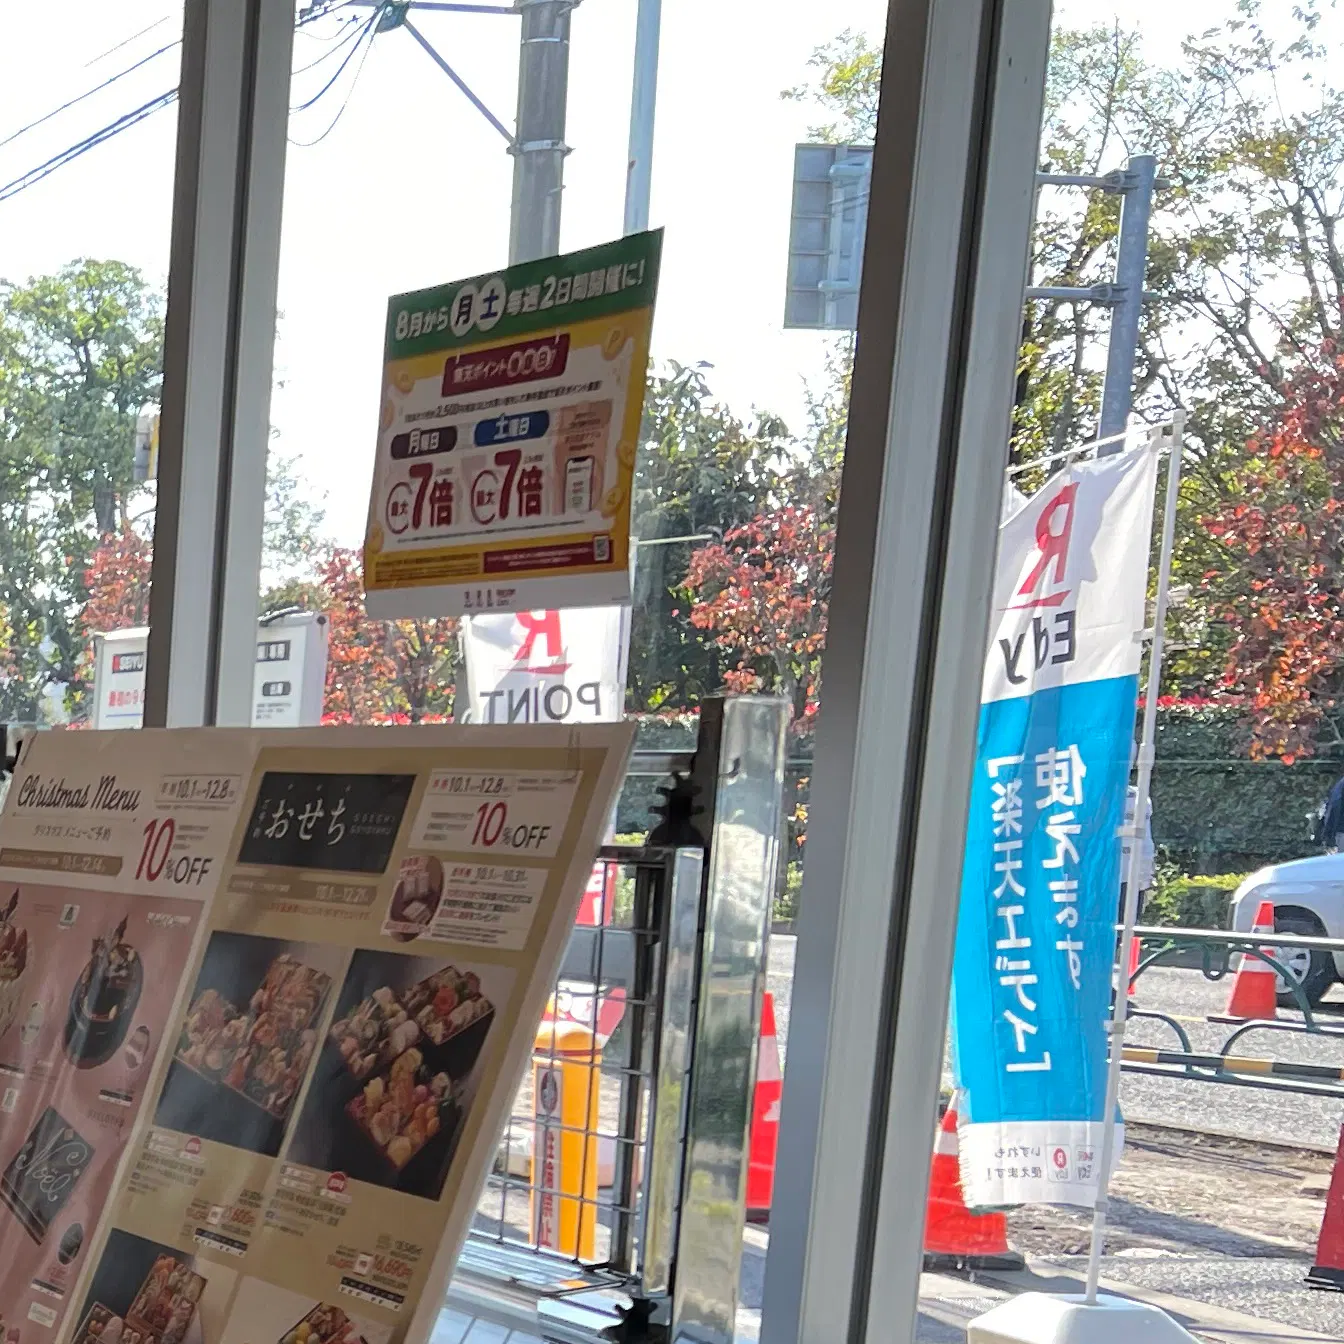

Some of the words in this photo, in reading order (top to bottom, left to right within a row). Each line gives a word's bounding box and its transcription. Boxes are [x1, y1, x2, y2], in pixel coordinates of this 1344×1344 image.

[17, 774, 91, 808] Christmas
[90, 775, 142, 812] Menu
[264, 797, 348, 846] おせち
